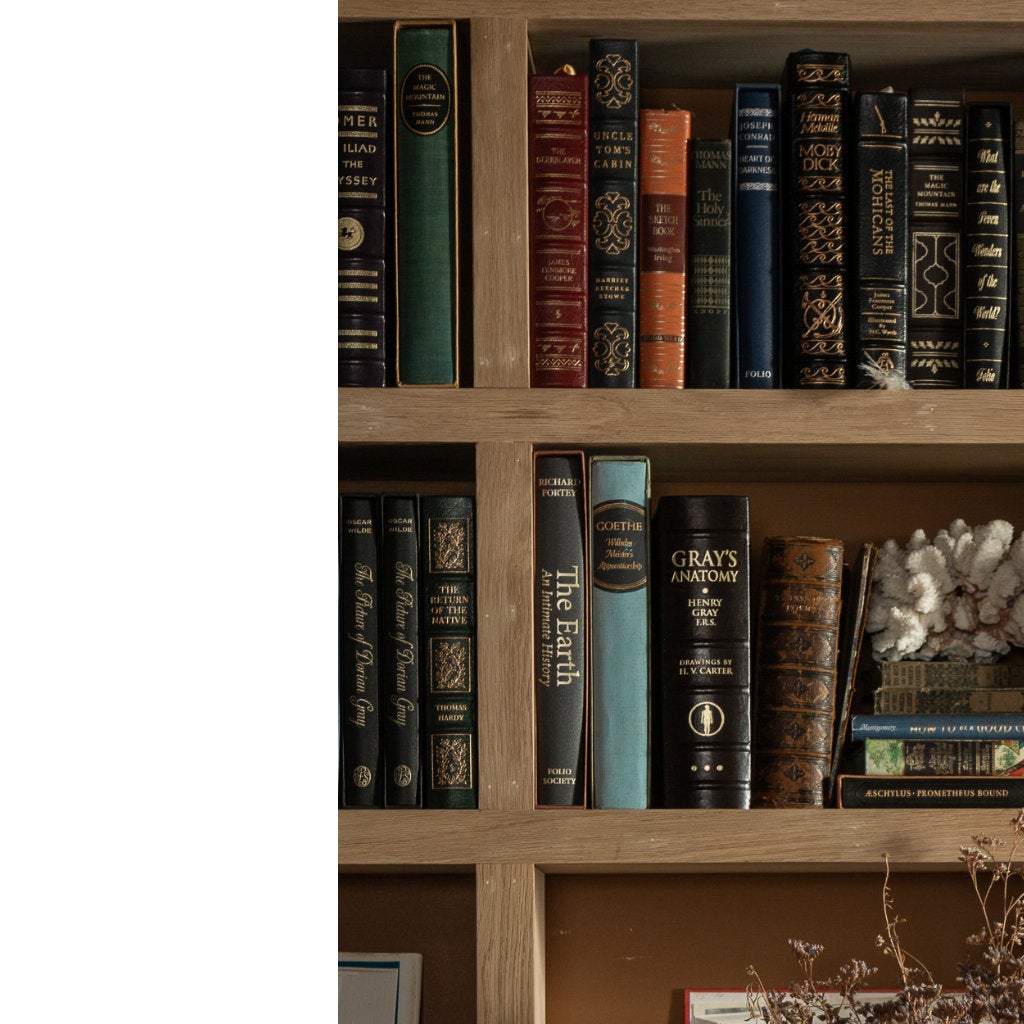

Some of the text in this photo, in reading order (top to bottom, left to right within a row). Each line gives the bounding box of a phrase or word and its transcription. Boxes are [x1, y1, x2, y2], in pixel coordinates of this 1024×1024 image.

[338, 115, 377, 127] MER
[593, 132, 633, 141] UNCLE
[343, 144, 377, 153] ILIAD
[595, 146, 631, 155] TOM'S
[799, 143, 842, 157] MOBY
[977, 149, 999, 163] What
[343, 160, 363, 168] THE
[594, 160, 632, 169] CABIN
[803, 158, 841, 171] DICK
[700, 187, 722, 201] The
[696, 201, 724, 217] Holy
[870, 168, 884, 255] MOHICANS
[885, 169, 894, 255] THE LAST OF THE
[745, 370, 772, 378] FOLIO
[538, 478, 580, 487] RICHARD
[542, 488, 577, 498] FORTEY
[596, 521, 643, 531] GOETHE
[671, 550, 738, 568] GRAY'S
[671, 570, 739, 583] ANATOMY
[440, 585, 459, 594] THE
[430, 596, 469, 604] RETURN
[688, 599, 723, 607] HENRY
[692, 608, 719, 617] GRAY
[432, 616, 468, 624] NATIVE
[539, 568, 554, 687] An Intimate History
[557, 565, 580, 687] The Earth
[348, 562, 374, 727] The Picture of Dorian Gray
[388, 561, 415, 727] The Picture of Dorian Gray
[699, 667, 734, 675] CARTER
[548, 768, 572, 776] FOLIO
[543, 777, 577, 785] SOCIETY
[917, 789, 975, 798] PROMETHEUS
[977, 789, 1009, 798] BOUND
